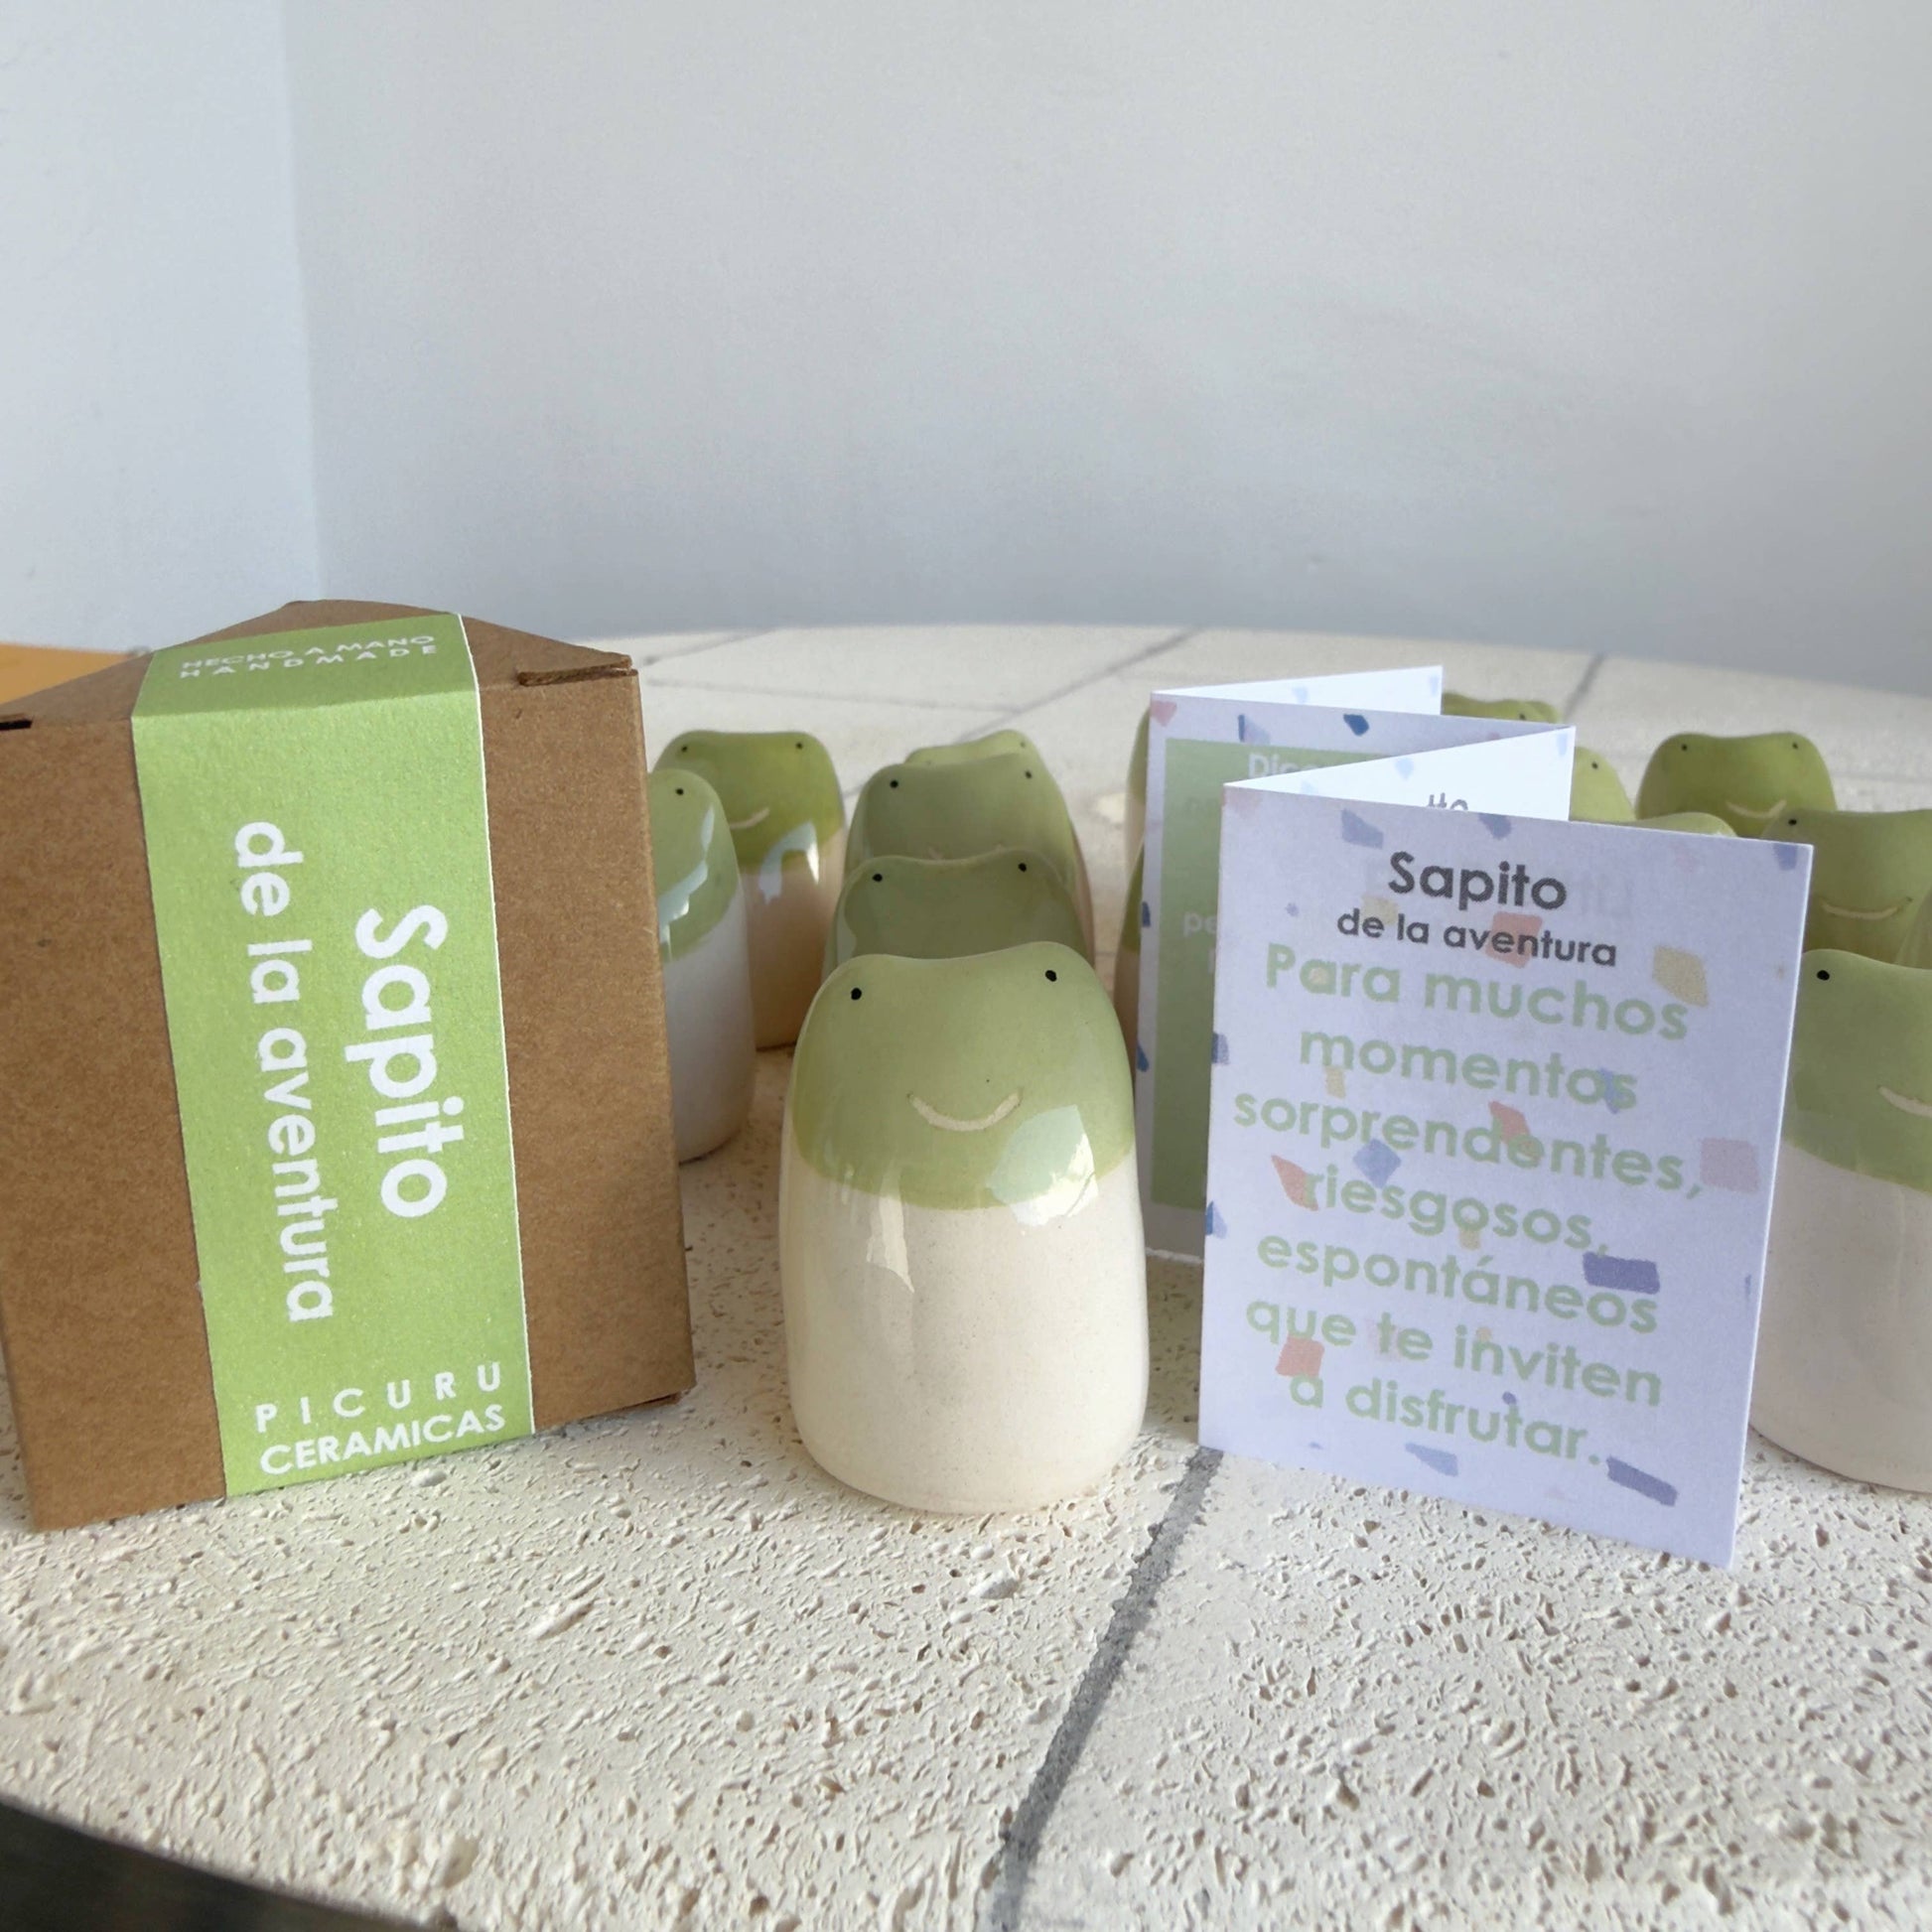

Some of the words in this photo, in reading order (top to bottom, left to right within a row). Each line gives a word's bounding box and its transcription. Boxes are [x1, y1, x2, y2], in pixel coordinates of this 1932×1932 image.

[182, 650, 294, 669] HECHO
[304, 646, 325, 655] A
[336, 635, 435, 651] MANO
[234, 821, 304, 916] de
[1388, 851, 1568, 911] Sapito
[247, 939, 313, 1004] la
[1337, 908, 1385, 938] de
[1397, 913, 1430, 944] la
[1444, 923, 1617, 967] aventura
[1266, 943, 1401, 1004] Para
[1425, 972, 1689, 1041] muchos
[345, 904, 465, 1218] Sapito
[1300, 1031, 1638, 1111] momentos
[257, 1028, 339, 1322] aventura
[1257, 1234, 1659, 1333] espontáneos
[1246, 1300, 1357, 1346] que
[1377, 1311, 1434, 1361] te
[1453, 1324, 1663, 1407] inviten
[255, 1362, 501, 1435] PICURU
[260, 1404, 506, 1475] CERAMICAS
[1290, 1373, 1324, 1408] a
[1345, 1377, 1601, 1465] disfrutar.
